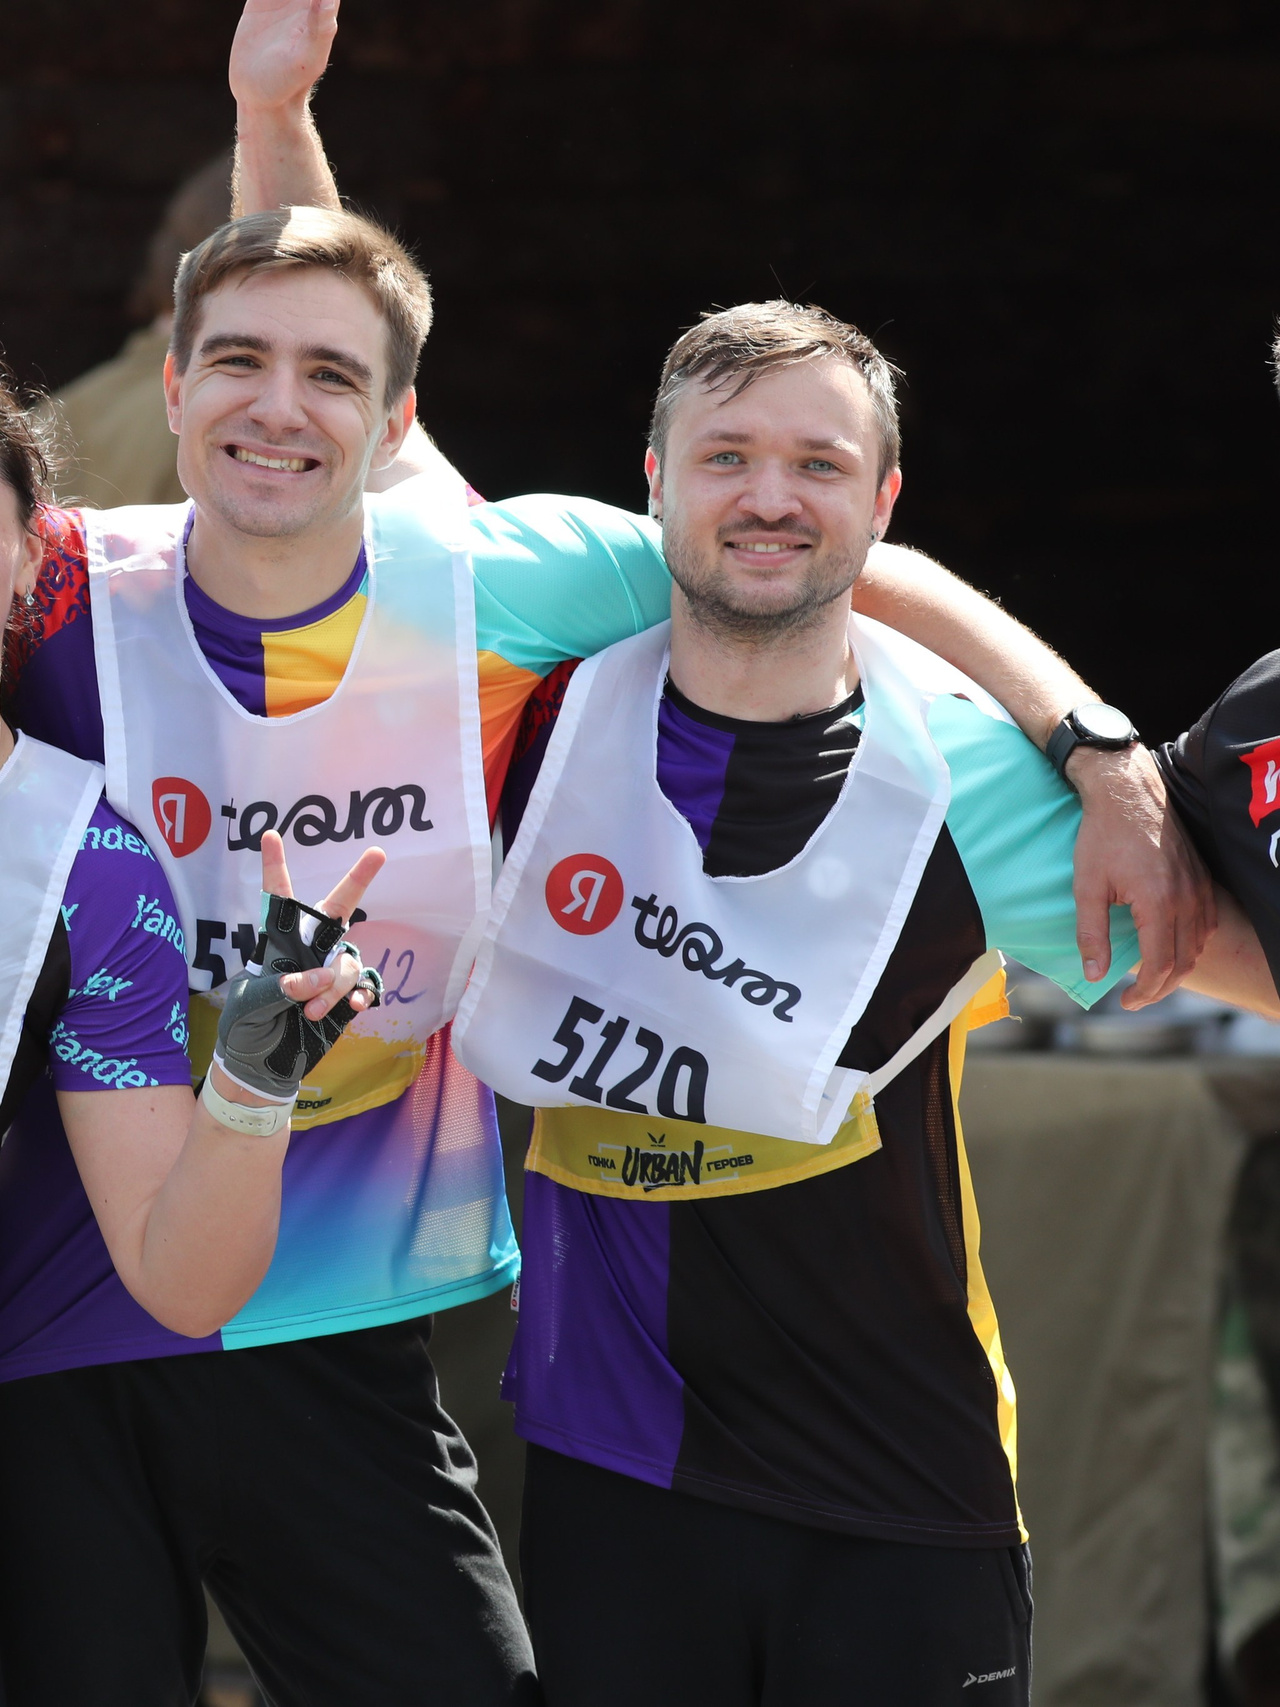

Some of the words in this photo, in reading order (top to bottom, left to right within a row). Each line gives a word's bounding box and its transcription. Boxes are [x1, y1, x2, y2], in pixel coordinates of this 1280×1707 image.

[78, 824, 156, 862] ndex
[221, 783, 434, 851] team
[631, 893, 802, 1023] team
[531, 995, 709, 1124] 5120
[588, 1154, 617, 1170] ГОНКА
[622, 1140, 704, 1187] URBAN
[706, 1154, 754, 1172] ГЕРОЕВ
[977, 1666, 1017, 1684] DEMIX
